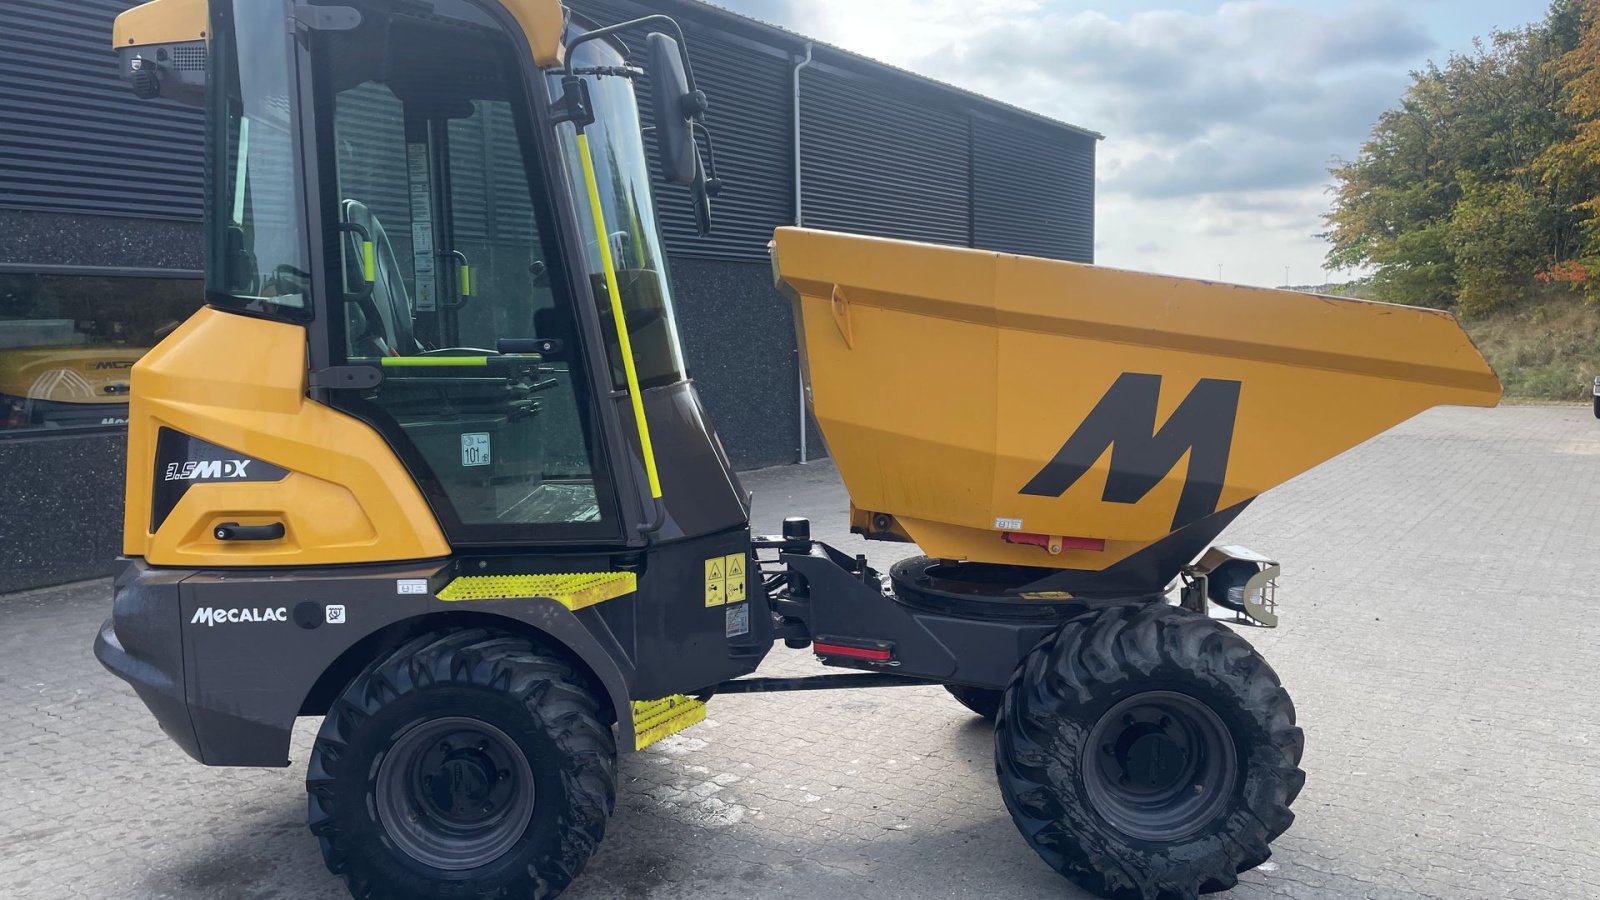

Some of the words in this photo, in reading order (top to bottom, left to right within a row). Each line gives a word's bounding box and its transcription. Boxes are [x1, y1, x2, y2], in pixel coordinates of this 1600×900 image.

[465, 447, 480, 463] 101
[1018, 371, 1242, 533] M
[164, 459, 251, 481] 3.5MDX
